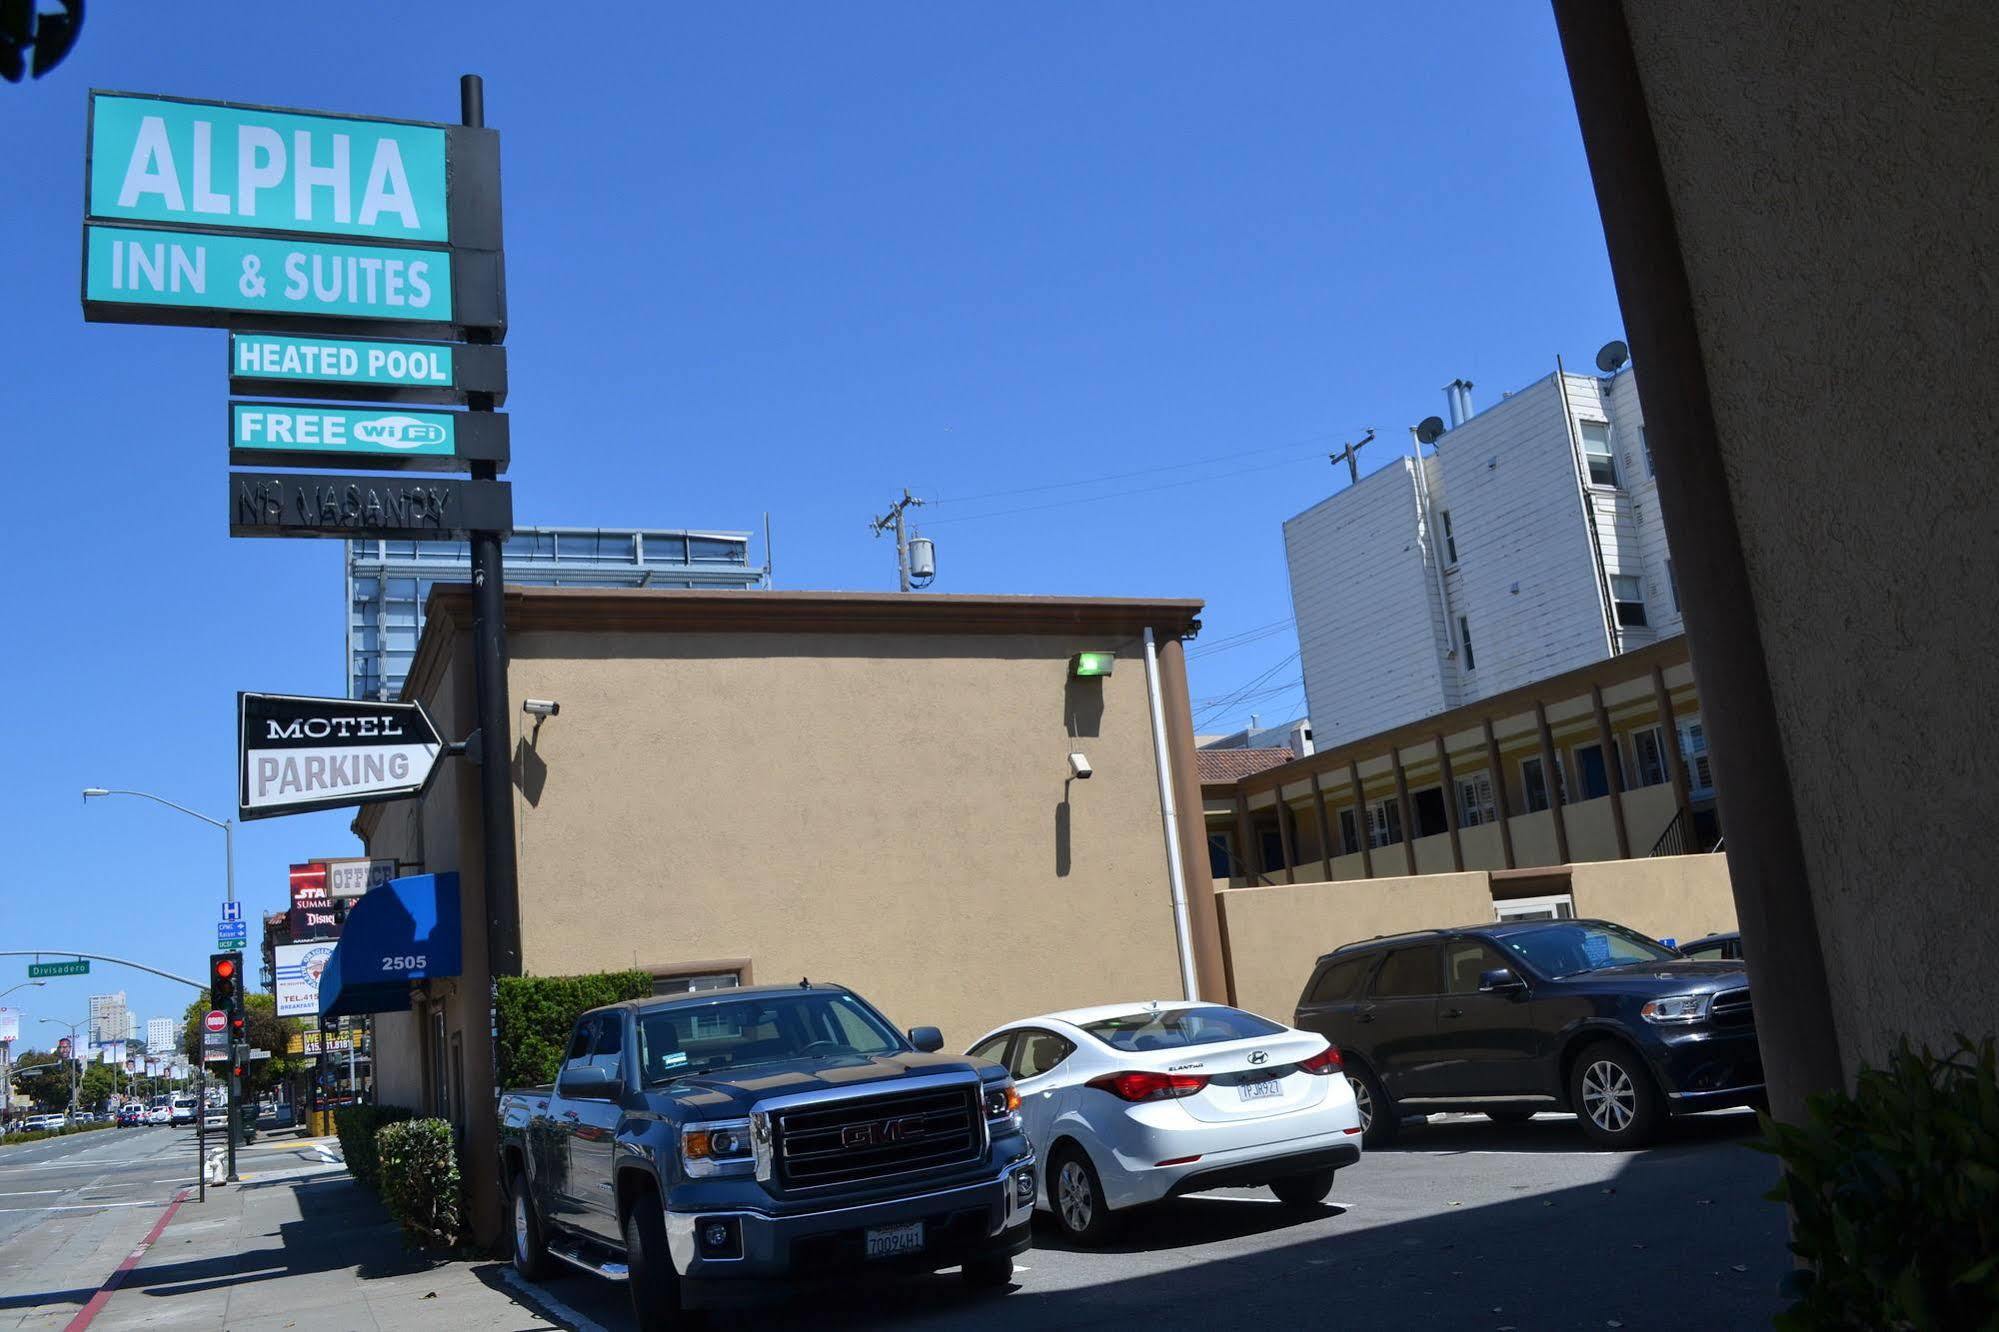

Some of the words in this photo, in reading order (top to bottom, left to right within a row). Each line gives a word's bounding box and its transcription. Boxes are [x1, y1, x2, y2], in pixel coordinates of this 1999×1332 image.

[117, 116, 420, 229] ALPHA
[112, 240, 206, 294] INN
[239, 254, 266, 299] &
[284, 252, 431, 309] SUITES
[240, 343, 358, 376] HEATED
[369, 349, 446, 380] POOL
[241, 413, 347, 445] FREE
[241, 480, 284, 514] NO
[266, 716, 402, 739] MOTEL
[258, 752, 409, 798] PARKING
[333, 866, 392, 889] OFFICE
[294, 888, 327, 899] STA
[297, 899, 333, 909] SUMME
[223, 903, 239, 919] H
[33, 965, 85, 975] Divisadero
[382, 955, 427, 970] 2505
[280, 1002, 314, 1011] BREAKFAST
